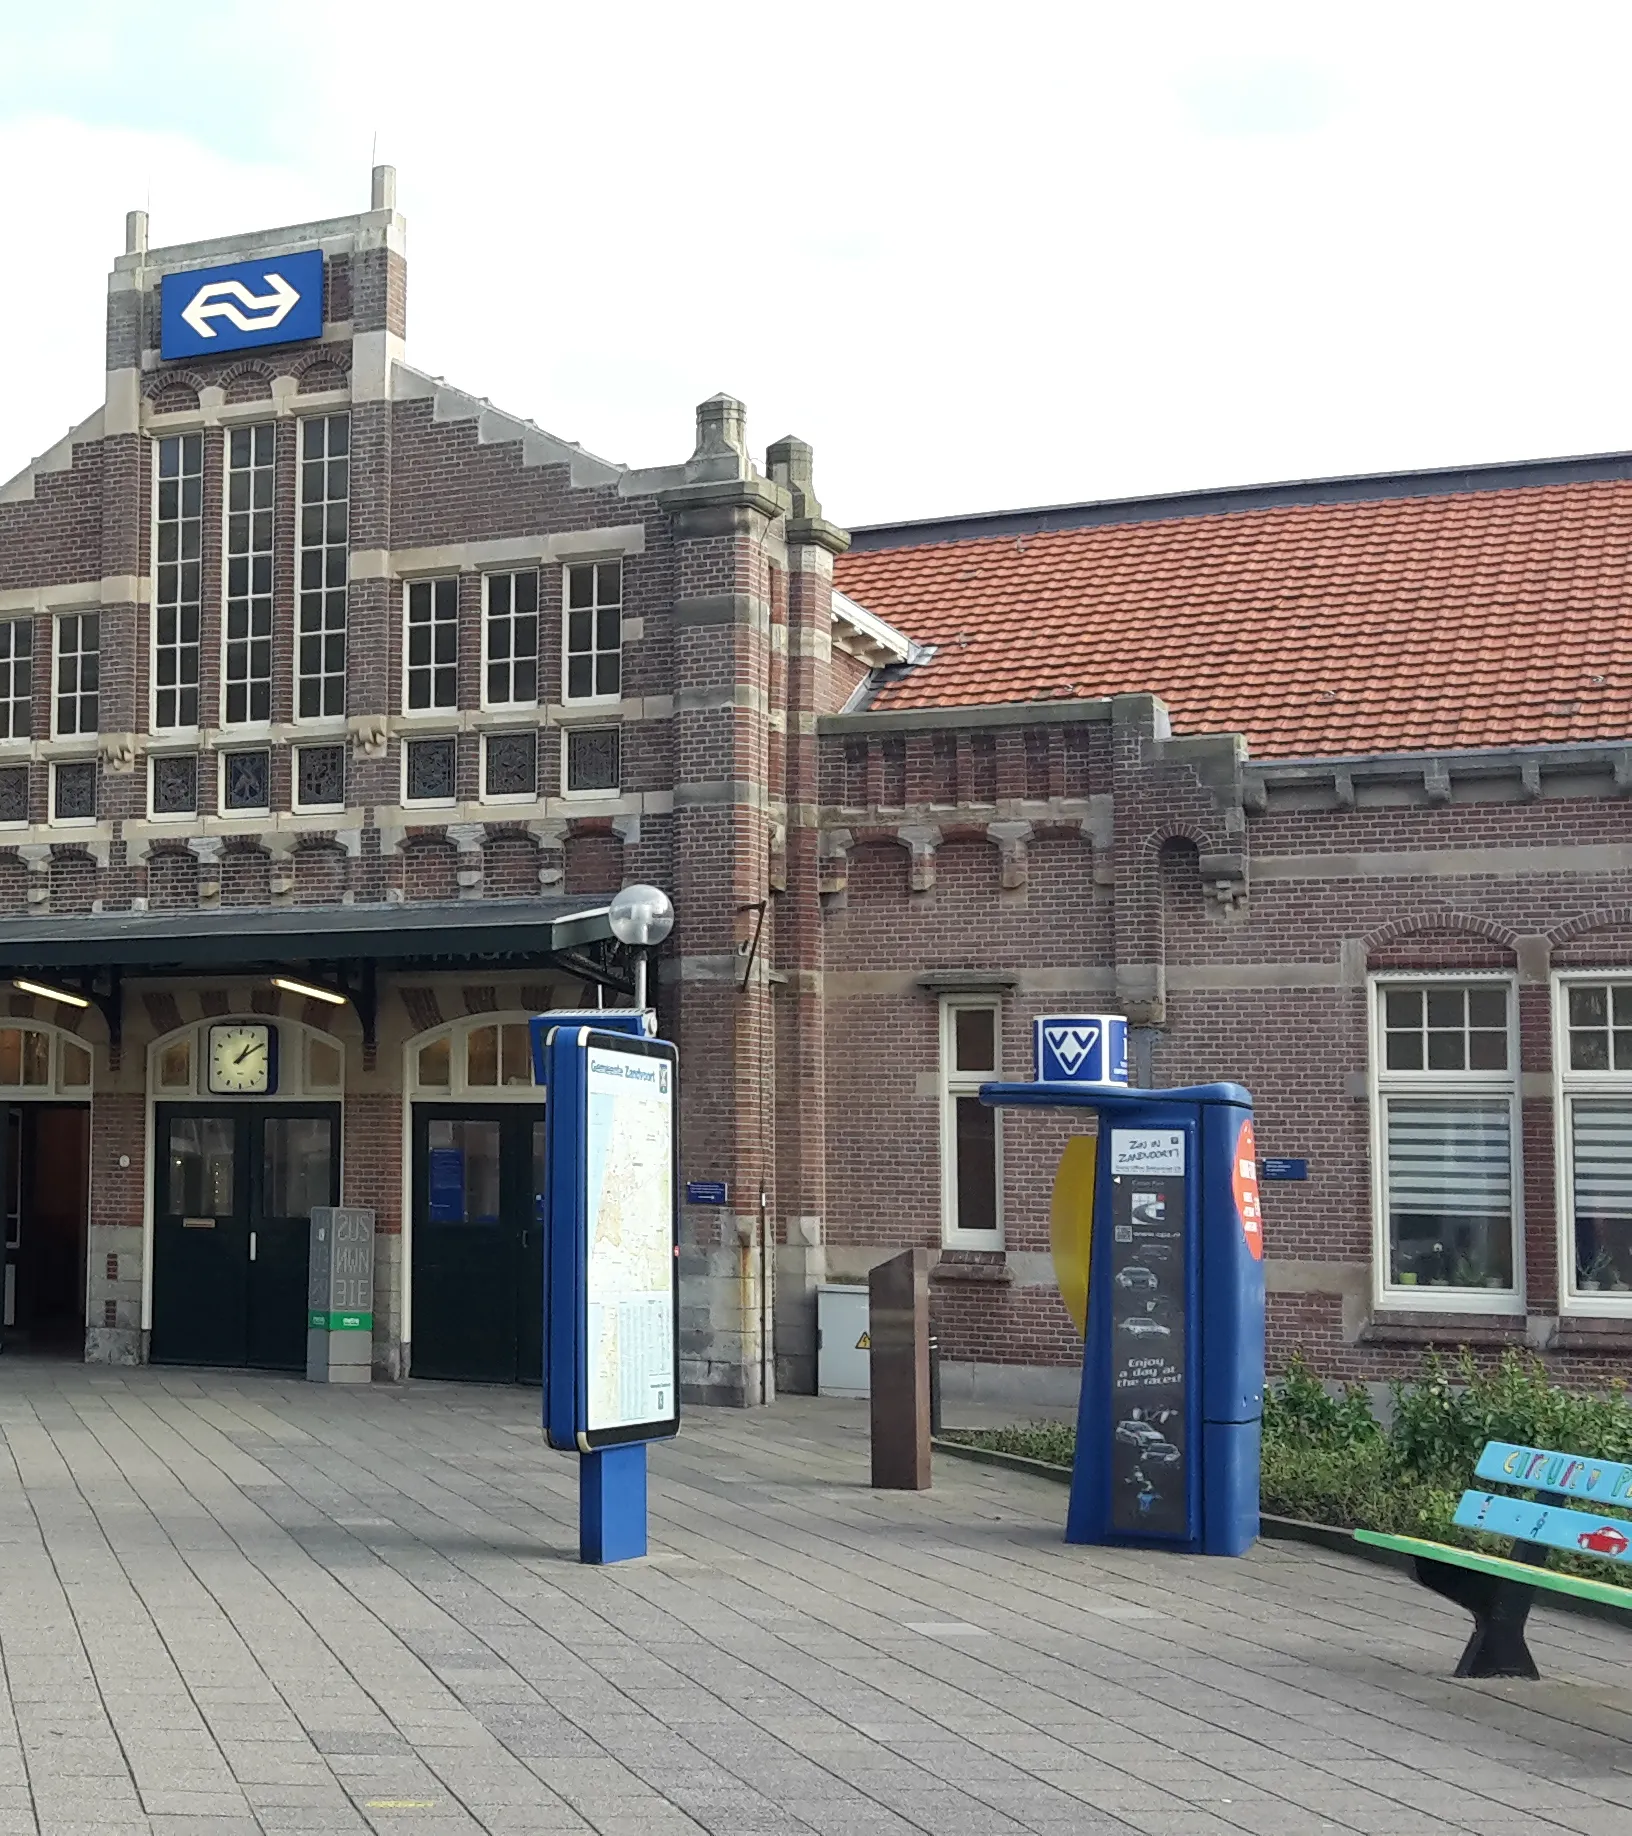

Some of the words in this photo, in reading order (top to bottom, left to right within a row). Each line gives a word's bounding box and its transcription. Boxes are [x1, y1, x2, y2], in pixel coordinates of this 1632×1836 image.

[1128, 1358, 1164, 1368] Enjoy
[1119, 1370, 1128, 1378] a
[1132, 1368, 1158, 1377] day
[1162, 1365, 1175, 1374] at
[1116, 1378, 1140, 1388] the
